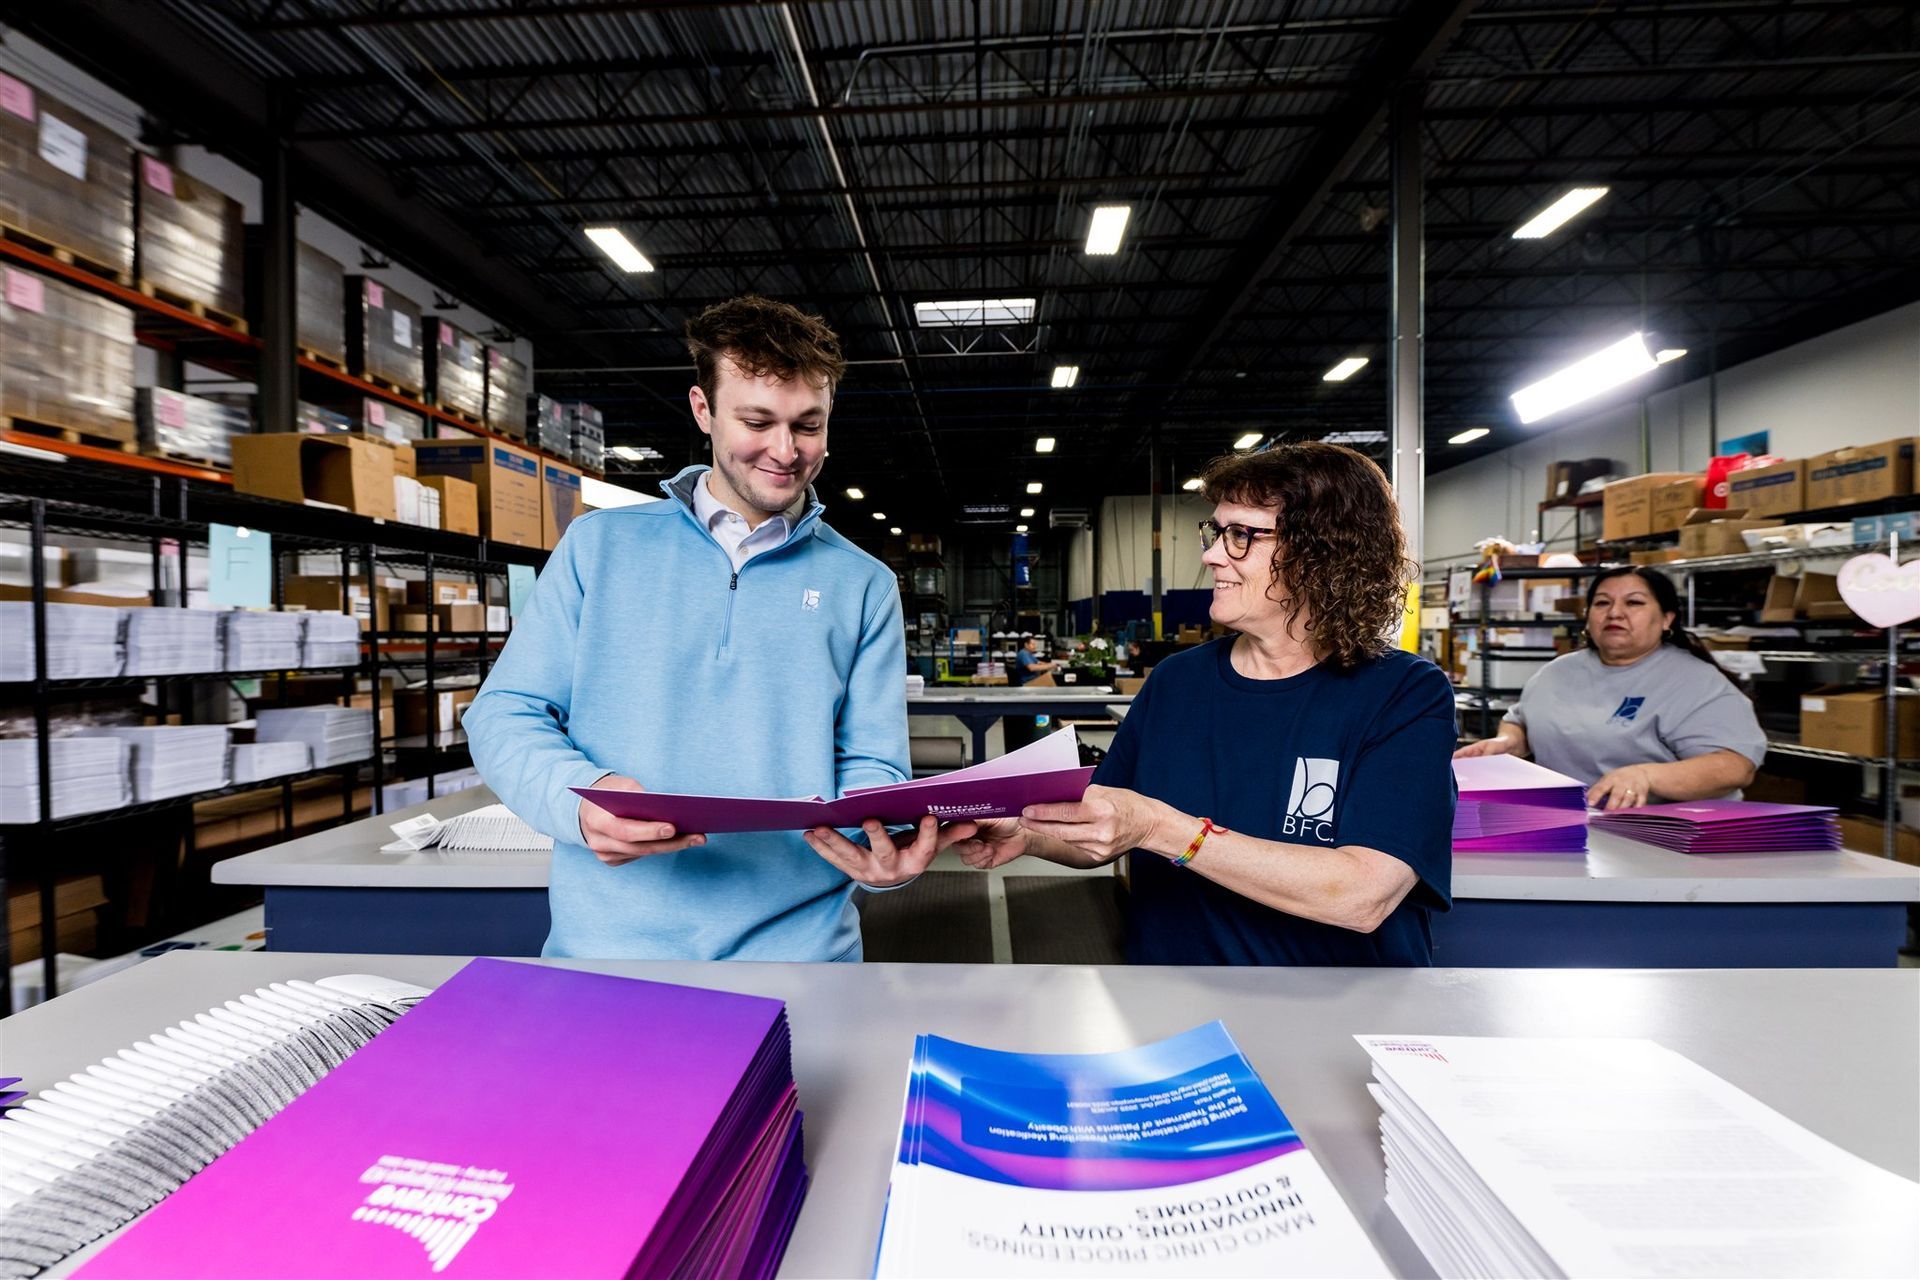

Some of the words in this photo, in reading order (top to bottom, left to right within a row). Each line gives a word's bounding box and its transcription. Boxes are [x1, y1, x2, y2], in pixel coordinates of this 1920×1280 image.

[226, 546, 254, 581] F
[1208, 1101, 1226, 1112] the
[1227, 1095, 1243, 1106] for
[1154, 1108, 1208, 1128] Treatment
[1209, 1103, 1248, 1122] Setting
[988, 1126, 1048, 1143] Medication
[1028, 1121, 1069, 1134] Obesity
[1070, 1125, 1096, 1134] With
[1096, 1122, 1140, 1133] Patients
[1141, 1117, 1210, 1138] Expectations
[1142, 1121, 1153, 1131] of
[1049, 1132, 1108, 1143] Prescribing
[1108, 1132, 1141, 1142] When
[1135, 1183, 1271, 1221] OUTCOMES
[1128, 1192, 1304, 1240] INNOVATIONS,
[1018, 1221, 1124, 1241] QUALITY
[1243, 1210, 1315, 1248] MAYO
[1152, 1237, 1238, 1262] CLINIC
